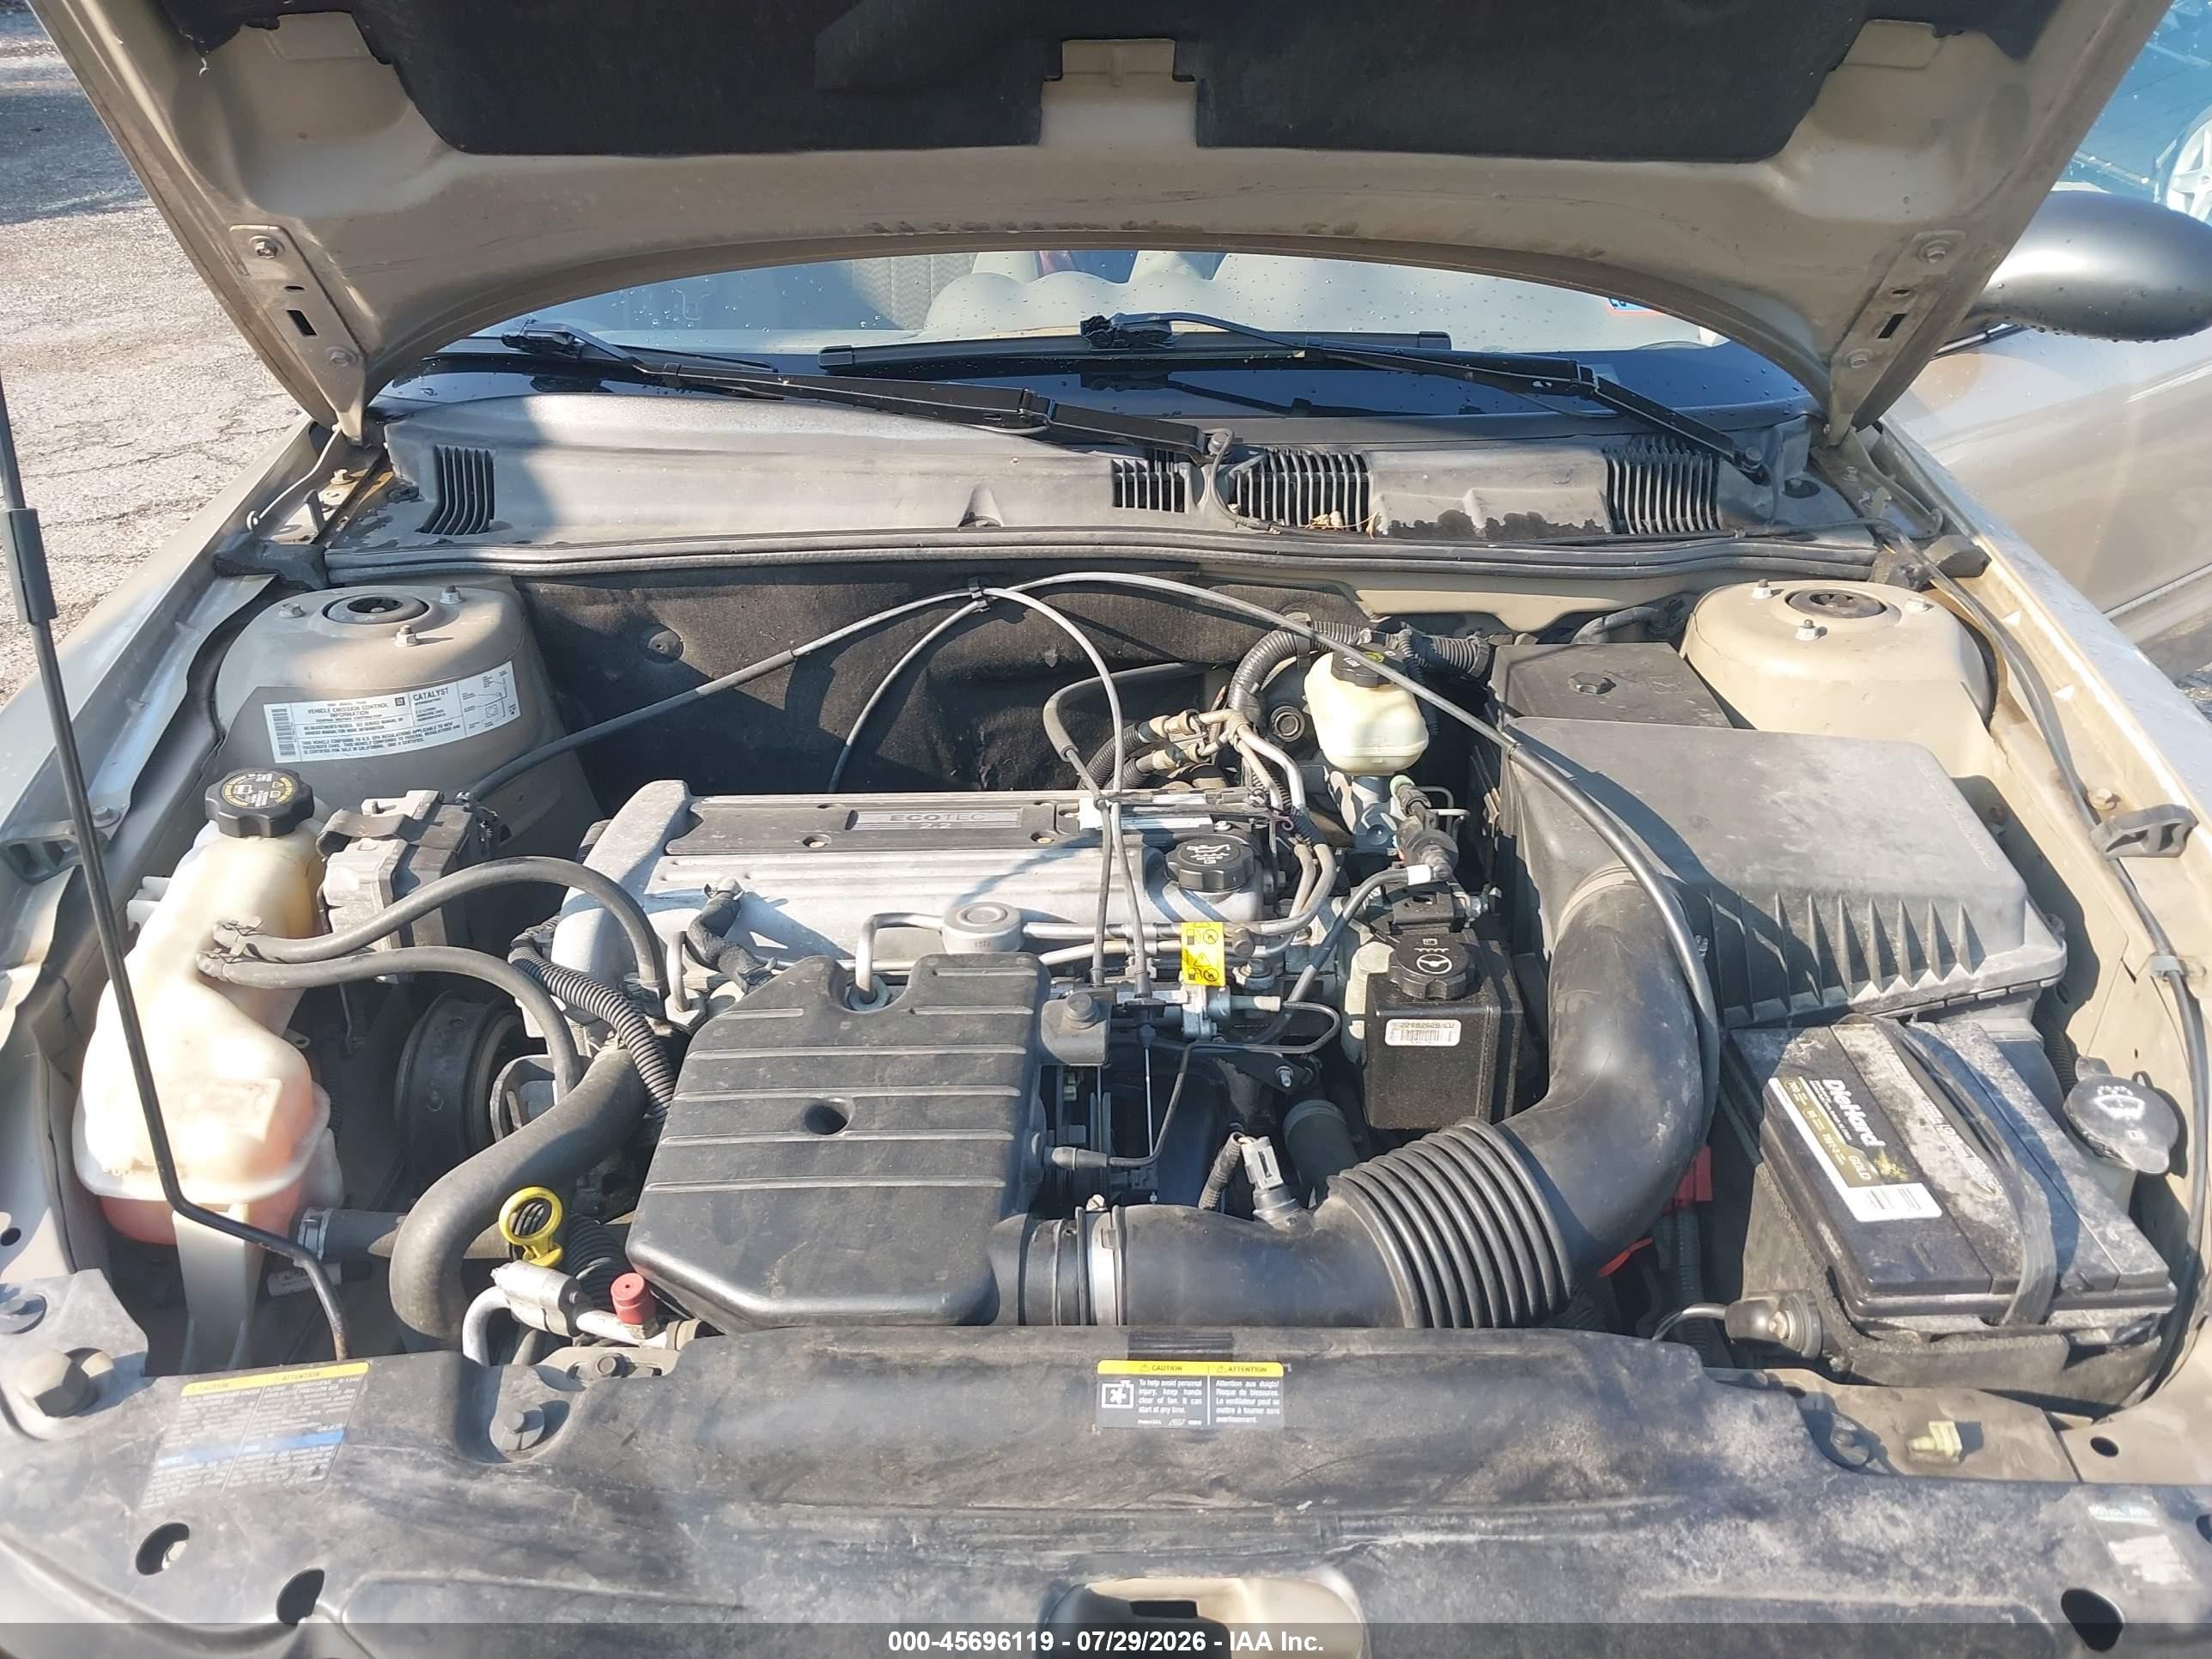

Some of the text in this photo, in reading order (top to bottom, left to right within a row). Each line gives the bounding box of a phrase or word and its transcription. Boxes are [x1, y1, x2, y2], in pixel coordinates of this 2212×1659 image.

[413, 687, 449, 701] CATALYST
[890, 813, 986, 822] ECOTEC
[1822, 1079, 1887, 1147] DieHard
[1848, 1155, 1872, 1182] GOLD
[1147, 1379, 1160, 1388] help
[1163, 1388, 1178, 1396] keep
[1139, 1396, 1155, 1405] clear
